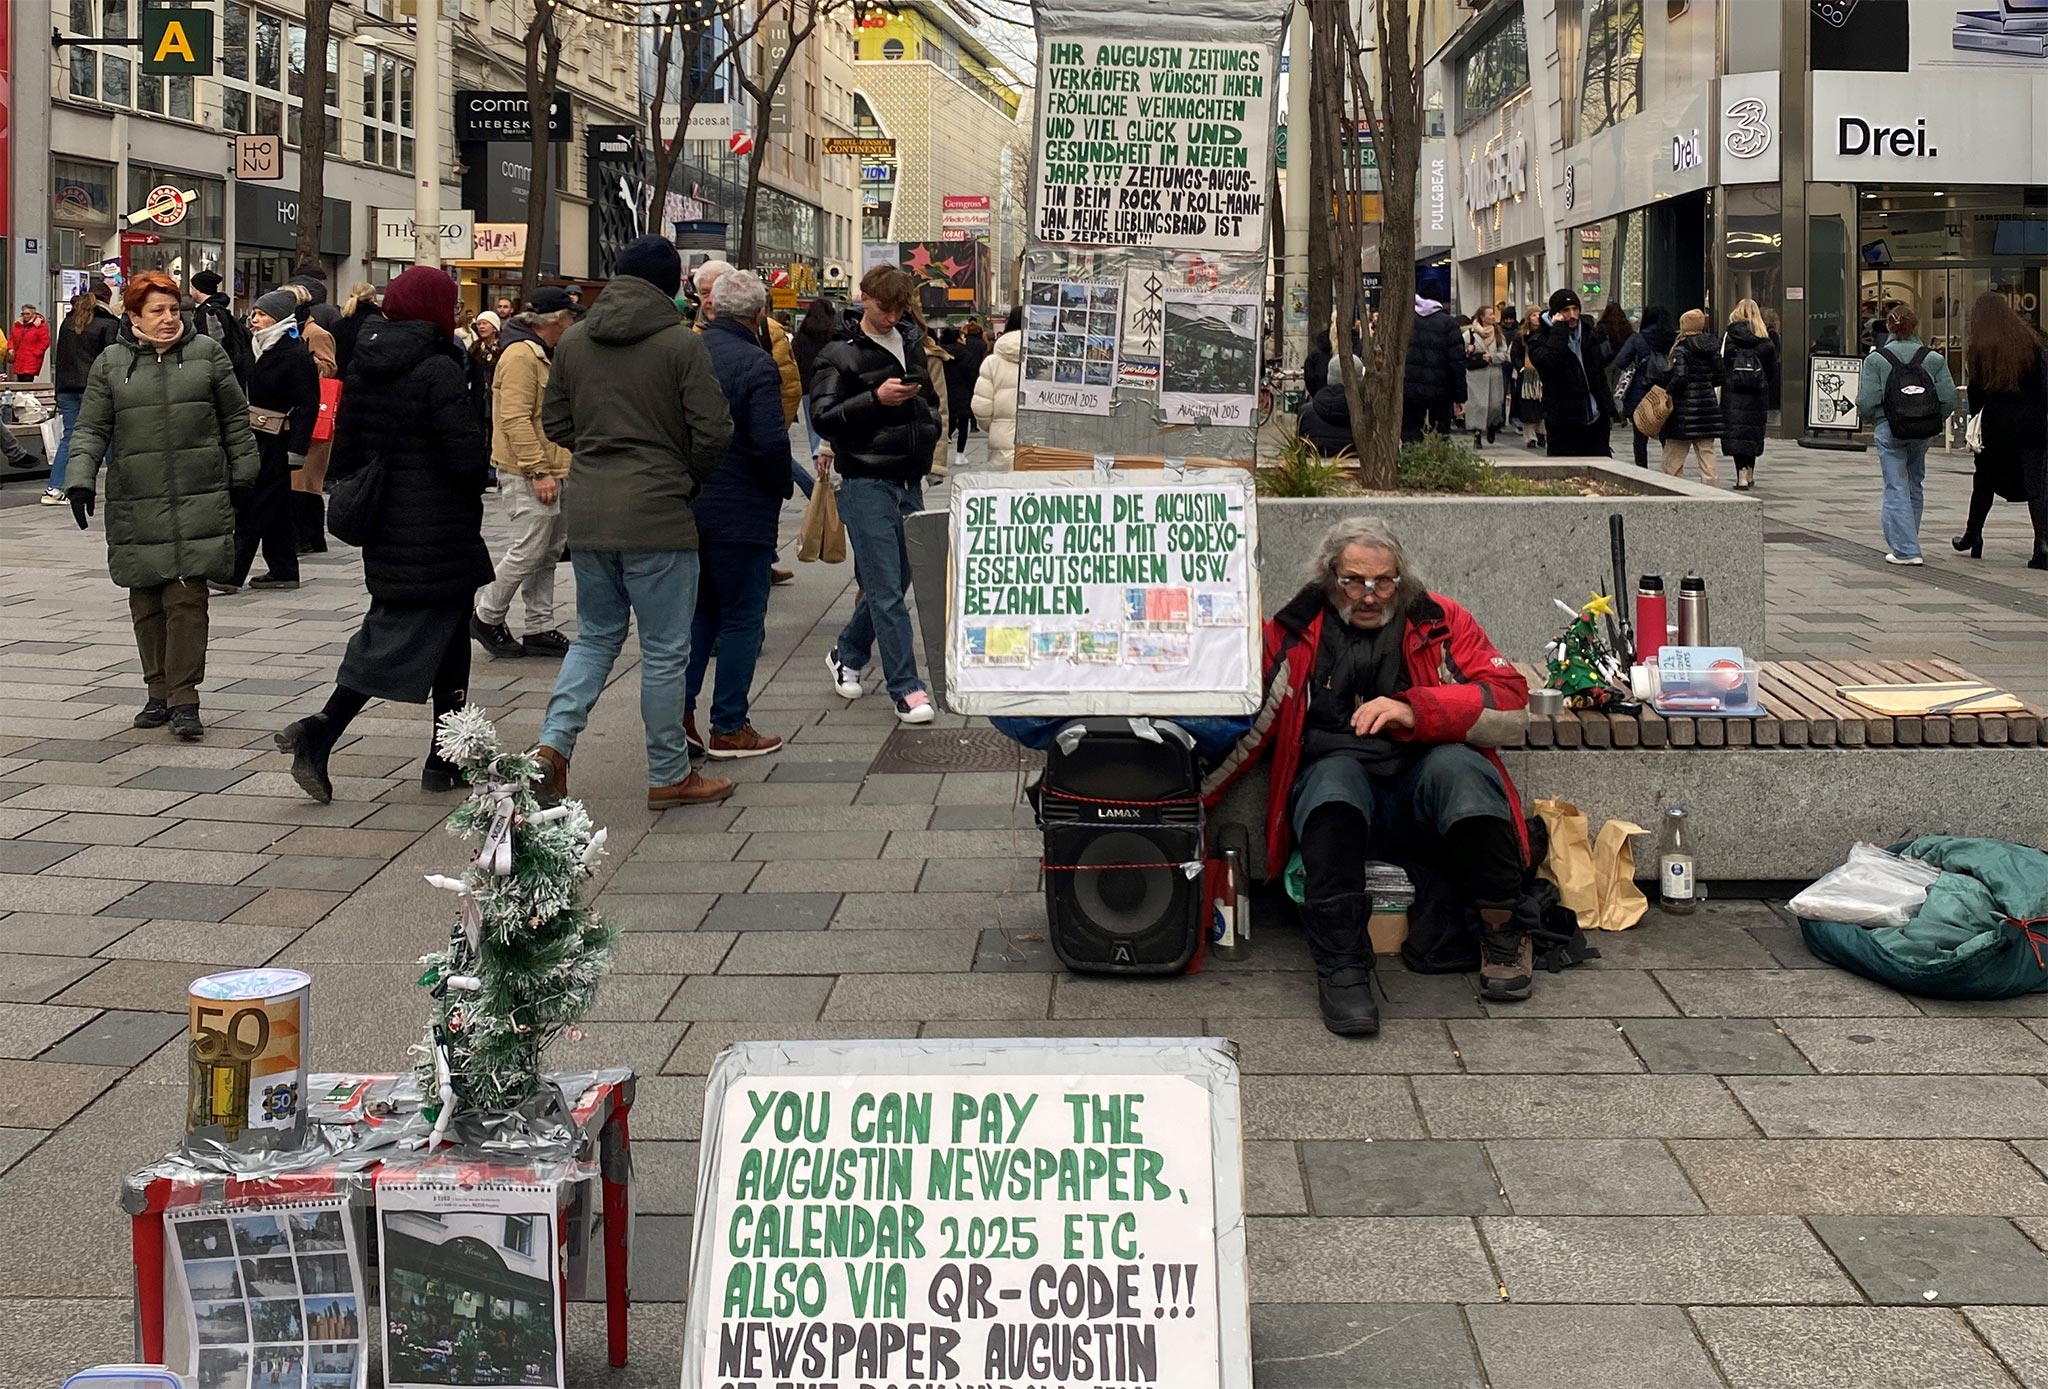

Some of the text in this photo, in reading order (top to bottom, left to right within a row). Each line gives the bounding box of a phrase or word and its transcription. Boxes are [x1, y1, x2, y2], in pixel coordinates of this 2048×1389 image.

[154, 21, 195, 62] A
[1050, 43, 1085, 65] IHR
[1188, 48, 1260, 72] ZEITUNGS
[771, 28, 787, 125] ESRIT
[1050, 67, 1263, 97] VERKÄUFER WÜNSCHT IHNEN
[1047, 90, 1246, 121] FRÖHLICHE WEIHNACHTEN
[470, 120, 558, 129] LIEBESKD
[1046, 117, 1242, 145] UND VIEL GLÜCK UND
[1837, 117, 1937, 157] Drei.
[829, 145, 893, 153] CONTINENTAL
[1045, 140, 1248, 169] GESUNDHEIT IM NEUEN
[1673, 129, 1701, 174] Drei.
[243, 158, 271, 171] NU
[1126, 166, 1257, 192] ZEITUNGS-AUGUS-
[944, 199, 981, 208] Gerngross
[1044, 185, 1067, 207] TIN
[1073, 186, 1111, 209] BEIM
[1431, 159, 1444, 231] PULL&BEAR
[1041, 229, 1153, 246] LED ZEPPELIN!!!
[1115, 211, 1206, 235] LIEBLINGSBAND
[1214, 216, 1242, 237] IST
[1038, 391, 1098, 409] AUGUSTIN 2025
[1176, 402, 1240, 420] AUGUSTIN 2025
[965, 492, 1243, 526] SIE KÖNNEN DIE AUGUSTIN-
[967, 522, 1246, 556] ZEITUNG AUCH MIT SODEXO-
[965, 554, 1231, 585] ESSENGUTSCHEINEN USW.
[963, 585, 1090, 616] BEZAHLEN.
[1098, 808, 1141, 818] LAMAX
[190, 1006, 270, 1062] 50
[271, 1093, 292, 1109] 50
[741, 1090, 1144, 1144] YOU CAN PAY THE
[736, 1148, 1189, 1204] AUGUSTIN NEWSPAPER,
[728, 1204, 1145, 1260] CALENDAR 2025 ETC.
[723, 1262, 826, 1319] ALSO
[848, 1262, 907, 1319] VIA
[718, 1322, 1157, 1382] NEWSPAPER AUGUSTIN
